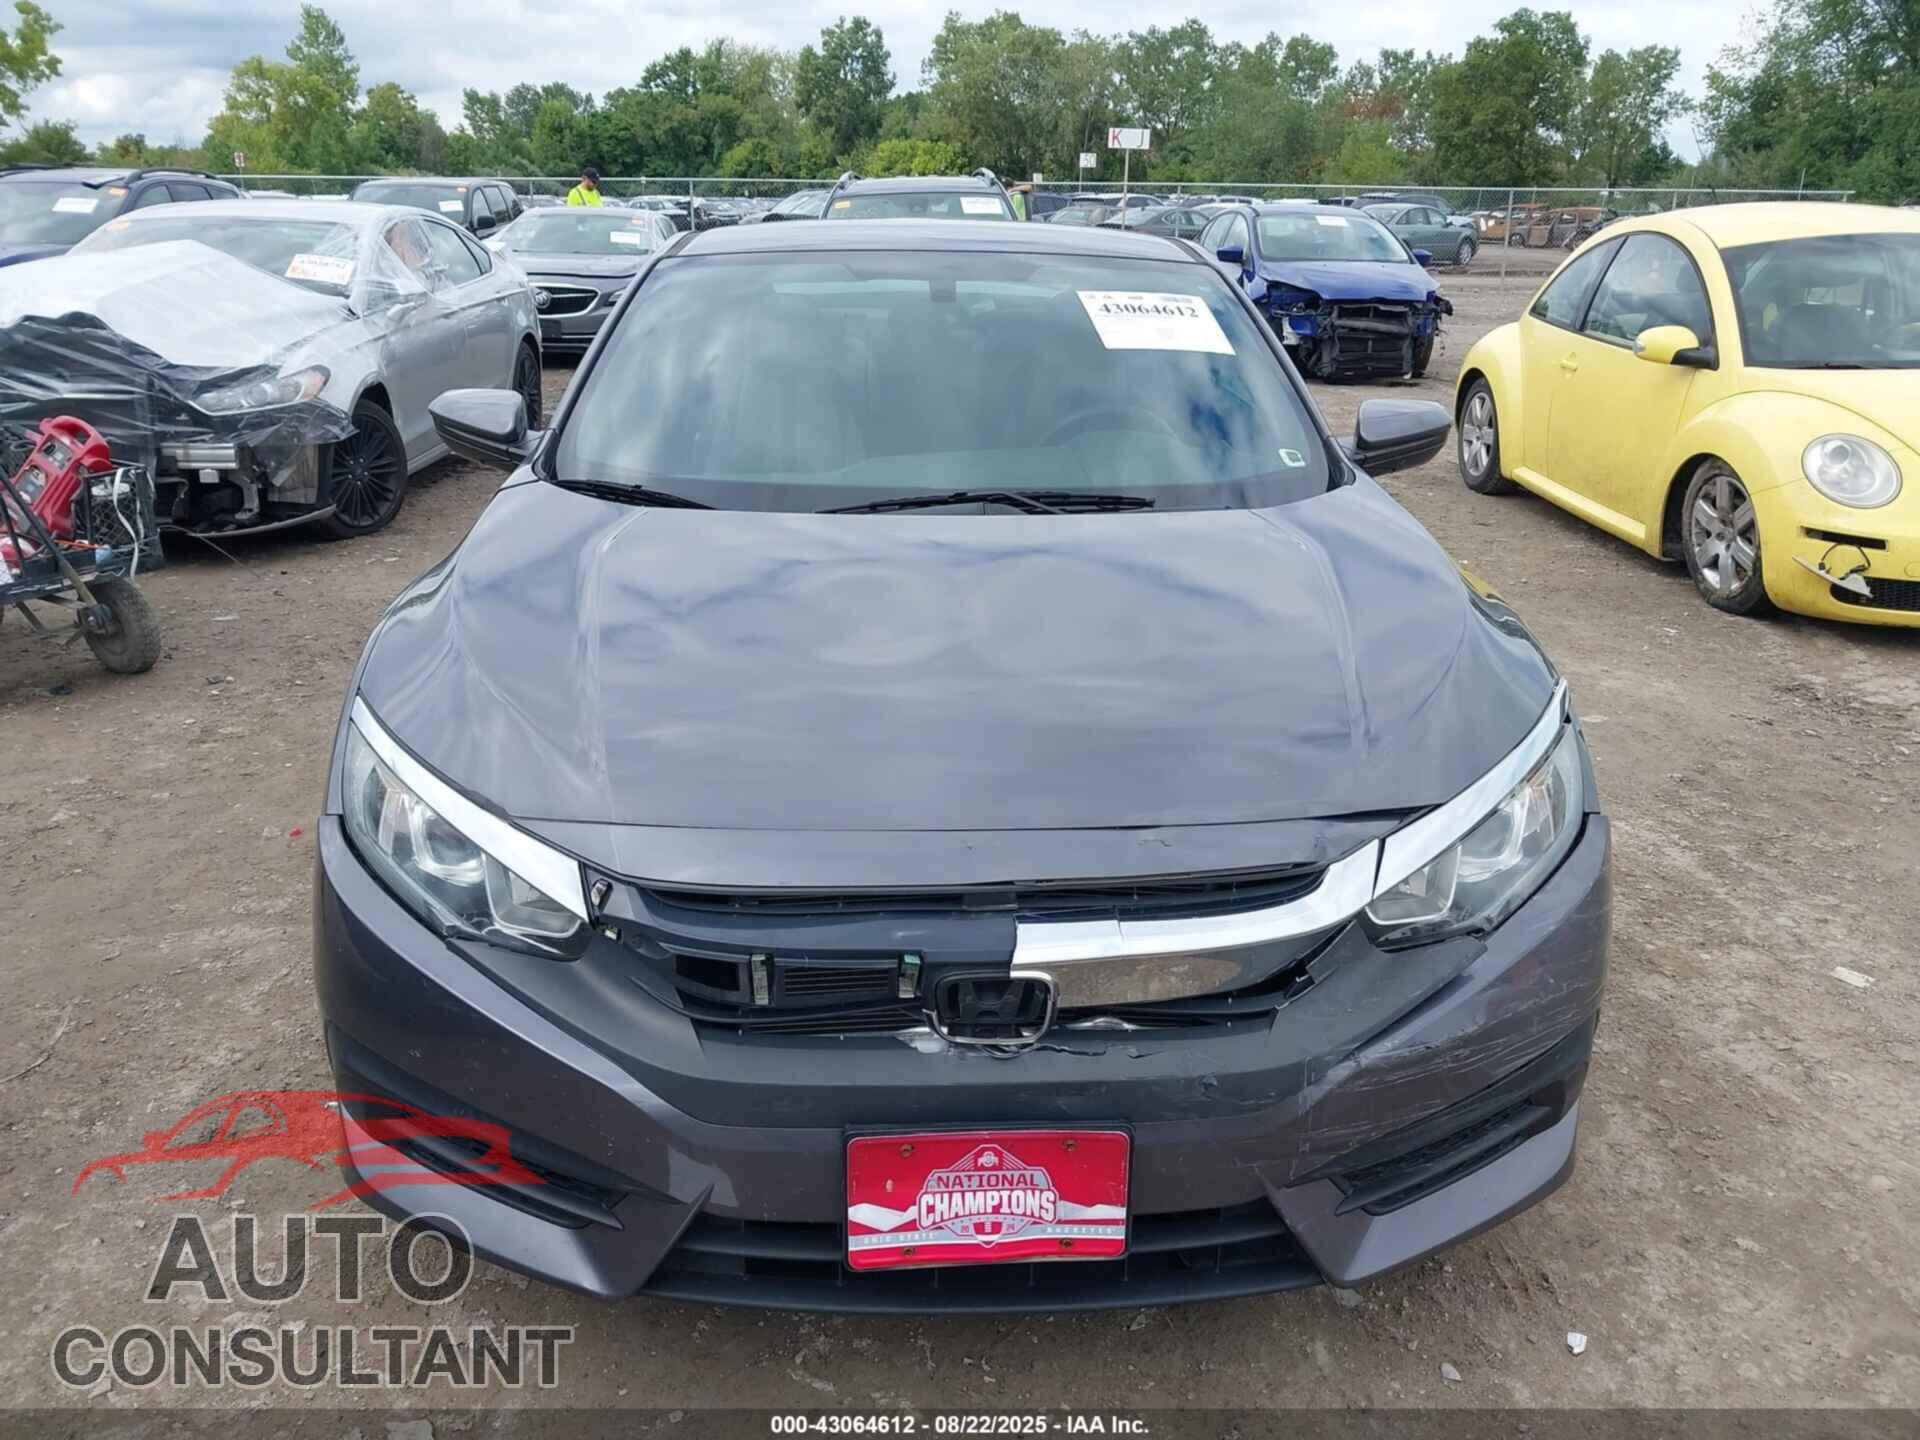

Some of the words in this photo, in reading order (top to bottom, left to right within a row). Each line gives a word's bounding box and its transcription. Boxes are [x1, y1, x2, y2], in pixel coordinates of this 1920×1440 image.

[1111, 128, 1122, 147] K
[1098, 303, 1199, 318] 43064612
[936, 1173, 1039, 1188] NATIONAL
[919, 1189, 1055, 1229] CHAMPIONS
